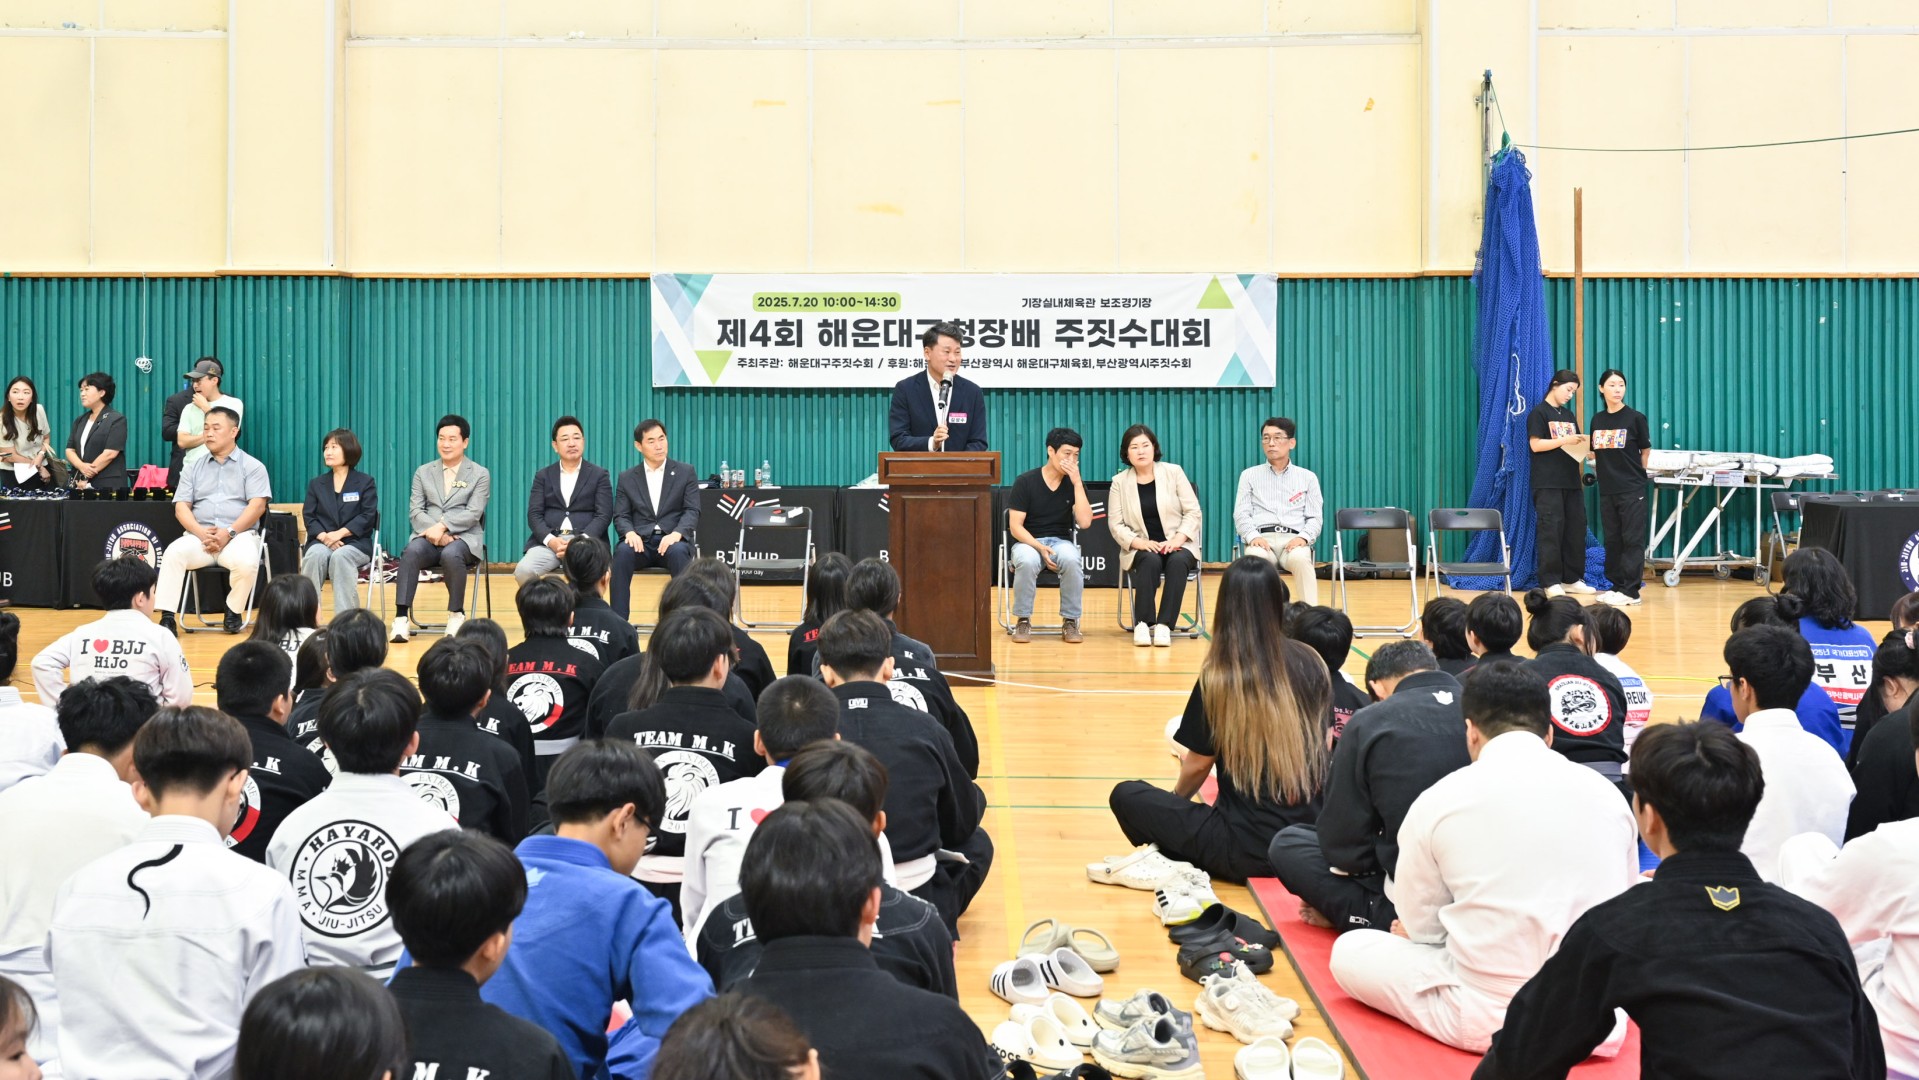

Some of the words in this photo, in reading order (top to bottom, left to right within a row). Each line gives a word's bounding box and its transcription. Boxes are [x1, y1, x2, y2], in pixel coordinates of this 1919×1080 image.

[757, 296, 819, 308] 2025.7.20
[822, 296, 897, 308] 10:00~14:30
[1021, 297, 1096, 309] 기장실내체육관
[1100, 297, 1152, 309] 보조경기장
[717, 318, 804, 348] 제4회
[1055, 318, 1211, 348] 주짓수대회
[737, 357, 784, 369] 주최주관:
[788, 357, 874, 369] 해운대구주짓수회
[80, 638, 91, 655] I
[110, 639, 147, 655] BJJ
[94, 655, 129, 669] HiJo
[507, 660, 537, 674] EAM
[634, 730, 684, 747] TEAM
[667, 822, 686, 830] 201
[296, 869, 312, 911] MMA
[318, 903, 383, 929] JIU-JITSU
